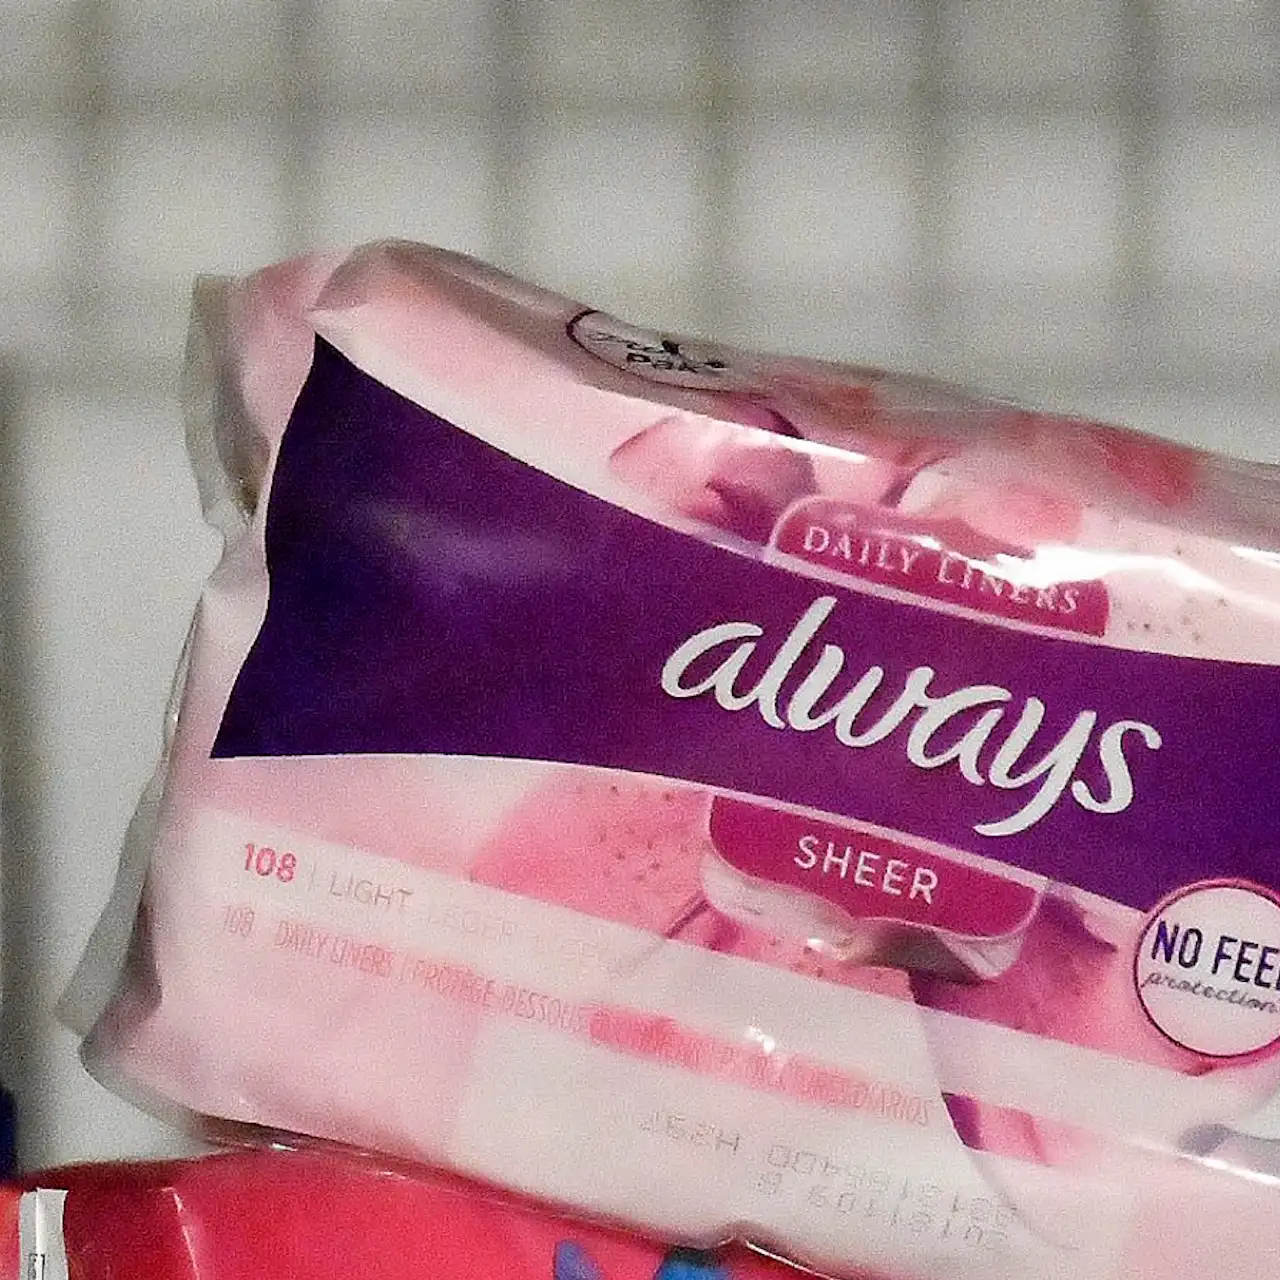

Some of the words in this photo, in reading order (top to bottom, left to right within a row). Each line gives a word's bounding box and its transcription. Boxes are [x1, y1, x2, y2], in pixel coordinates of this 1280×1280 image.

[802, 525, 917, 574] DAILY
[935, 556, 1080, 616] LINERS
[661, 596, 1163, 838] always
[244, 843, 298, 884] 108
[328, 873, 414, 910] LIGHT
[793, 835, 940, 906] SHEER
[1151, 918, 1203, 969] NO
[1211, 935, 1280, 991] FEE
